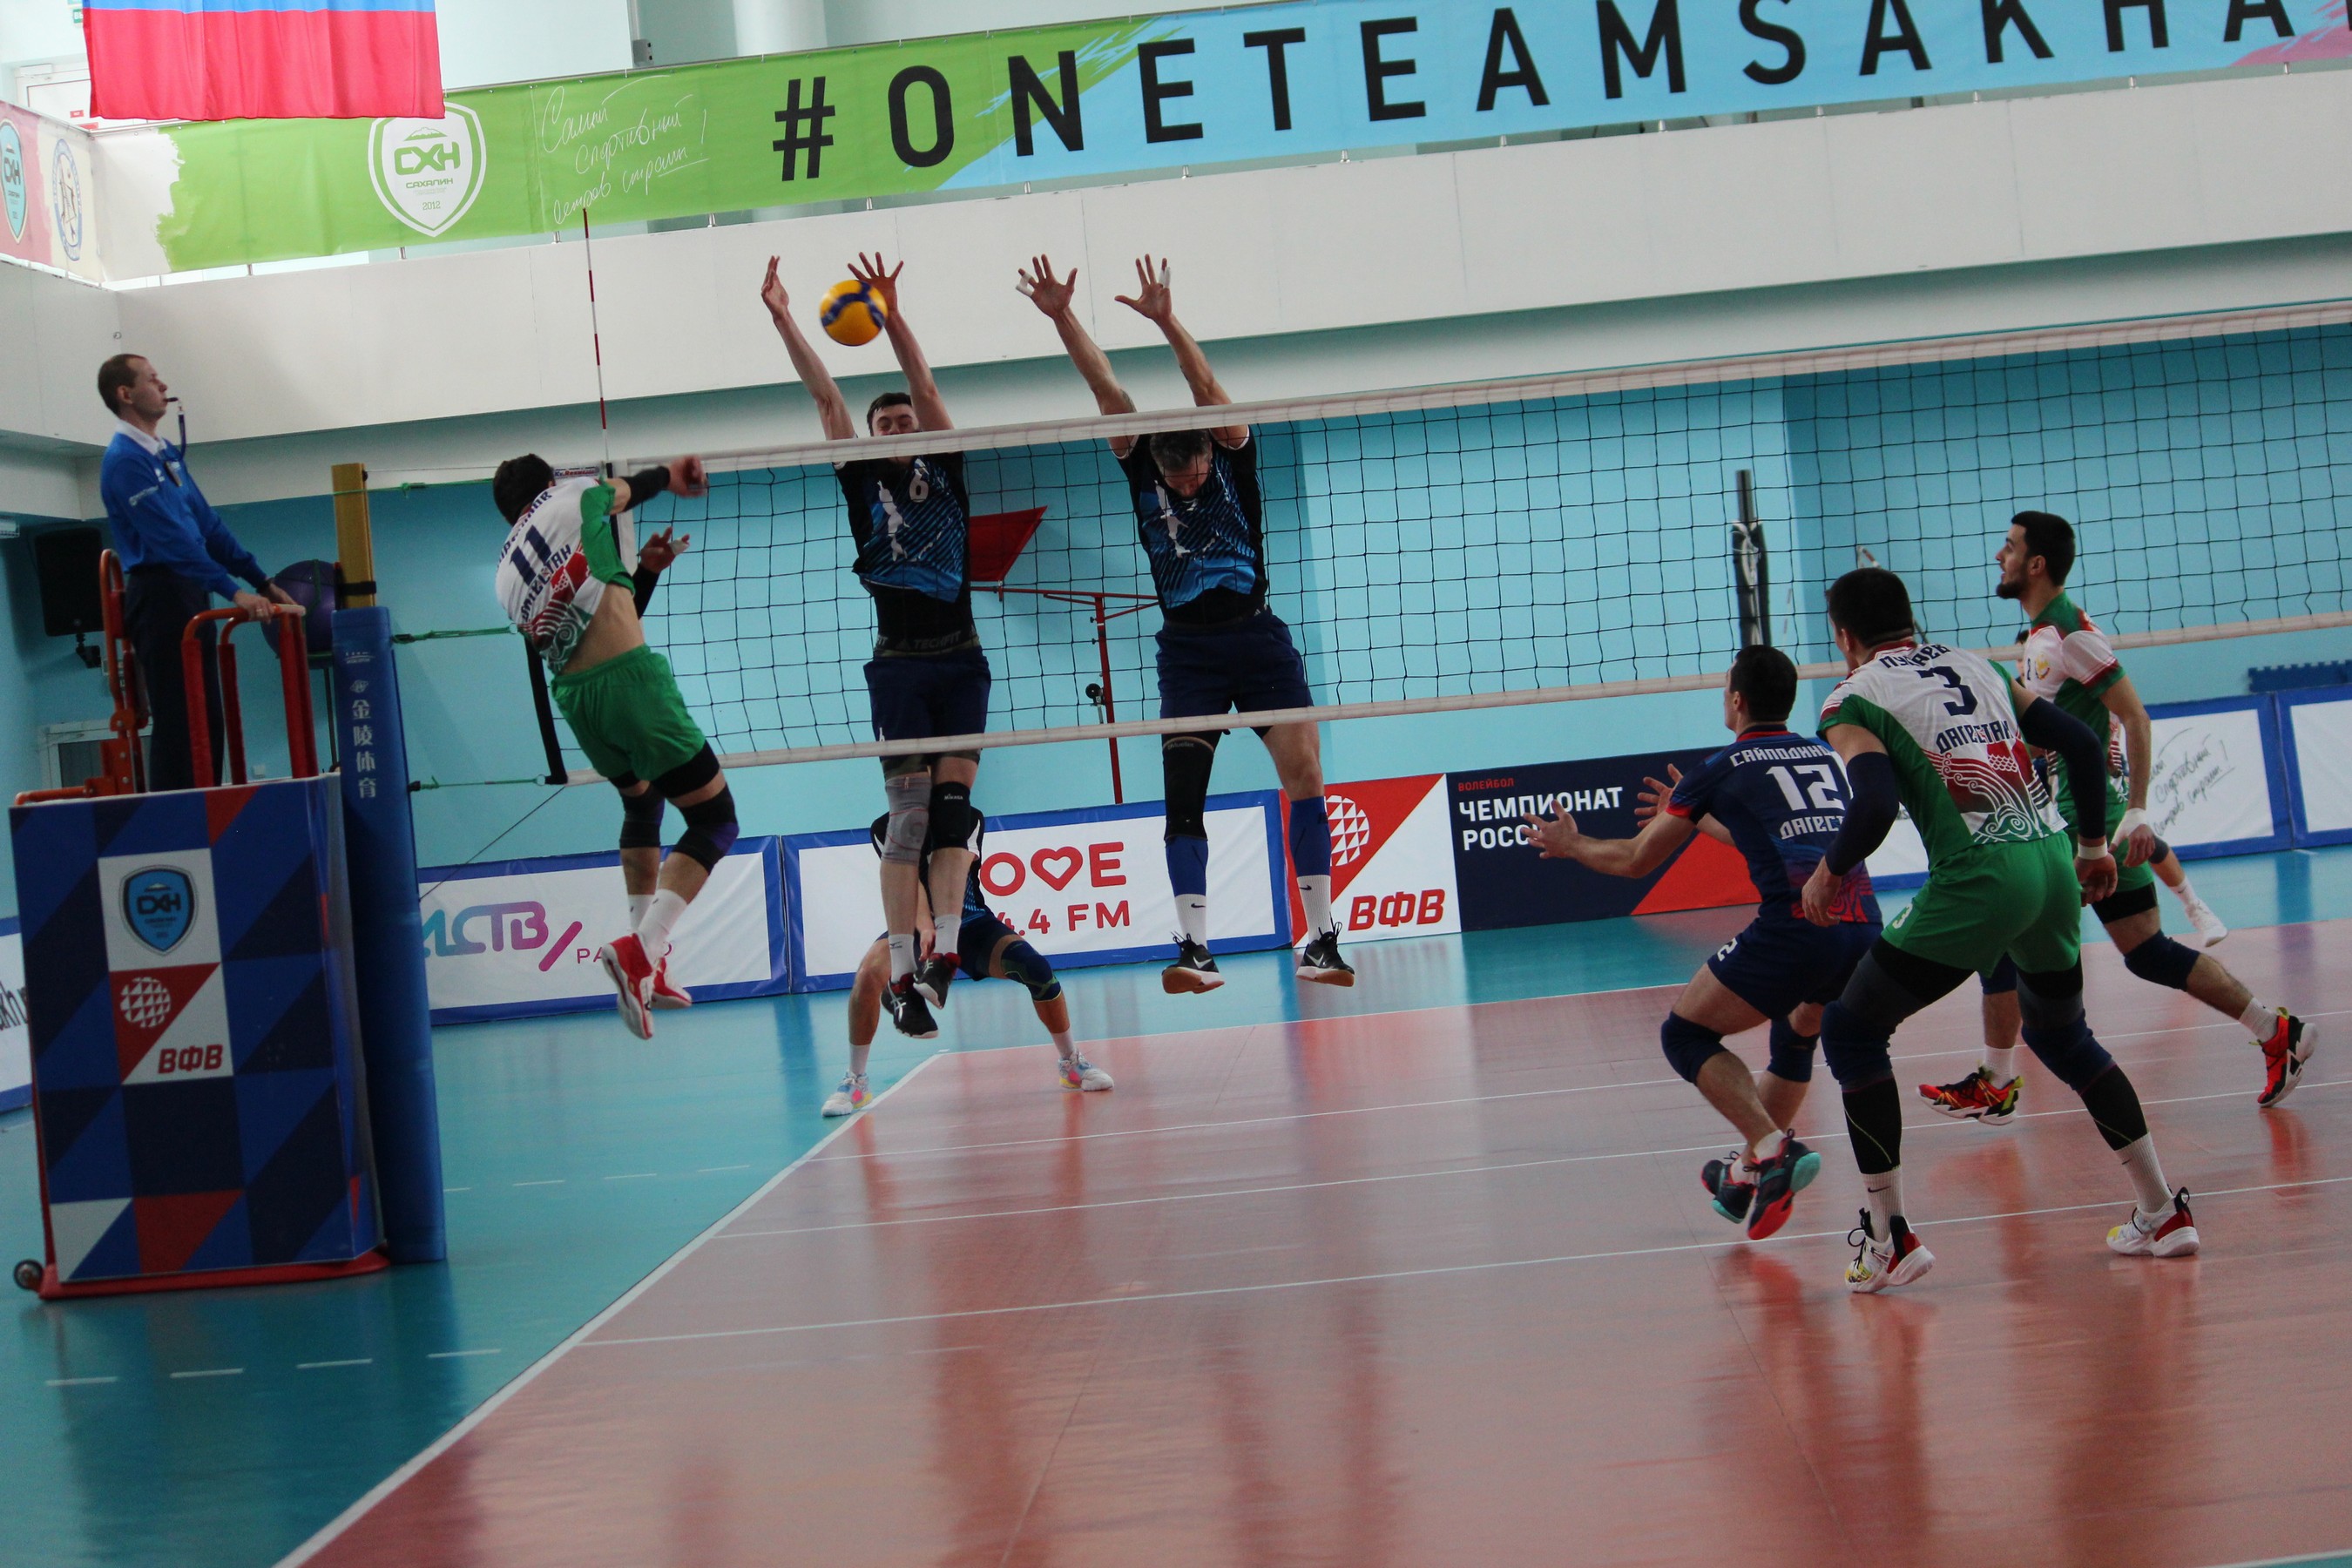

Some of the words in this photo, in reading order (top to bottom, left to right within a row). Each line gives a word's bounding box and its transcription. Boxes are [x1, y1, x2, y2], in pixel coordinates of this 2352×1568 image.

[422, 200, 442, 211] 2012
[510, 524, 552, 586] 11
[1916, 666, 1978, 716] 3
[351, 699, 377, 799] 金陵体育
[1936, 720, 2014, 754] ДАГЕСТАН
[1457, 778, 1515, 792] ВОЛЕЙБОЛ
[1765, 763, 1846, 812] 12
[1458, 787, 1624, 822] ЧЕМПИОНАТ
[1463, 823, 1538, 851] РОСС
[1067, 900, 1130, 931] FM
[1348, 889, 1446, 931] ВФВ
[158, 1044, 224, 1074] ВФВ
